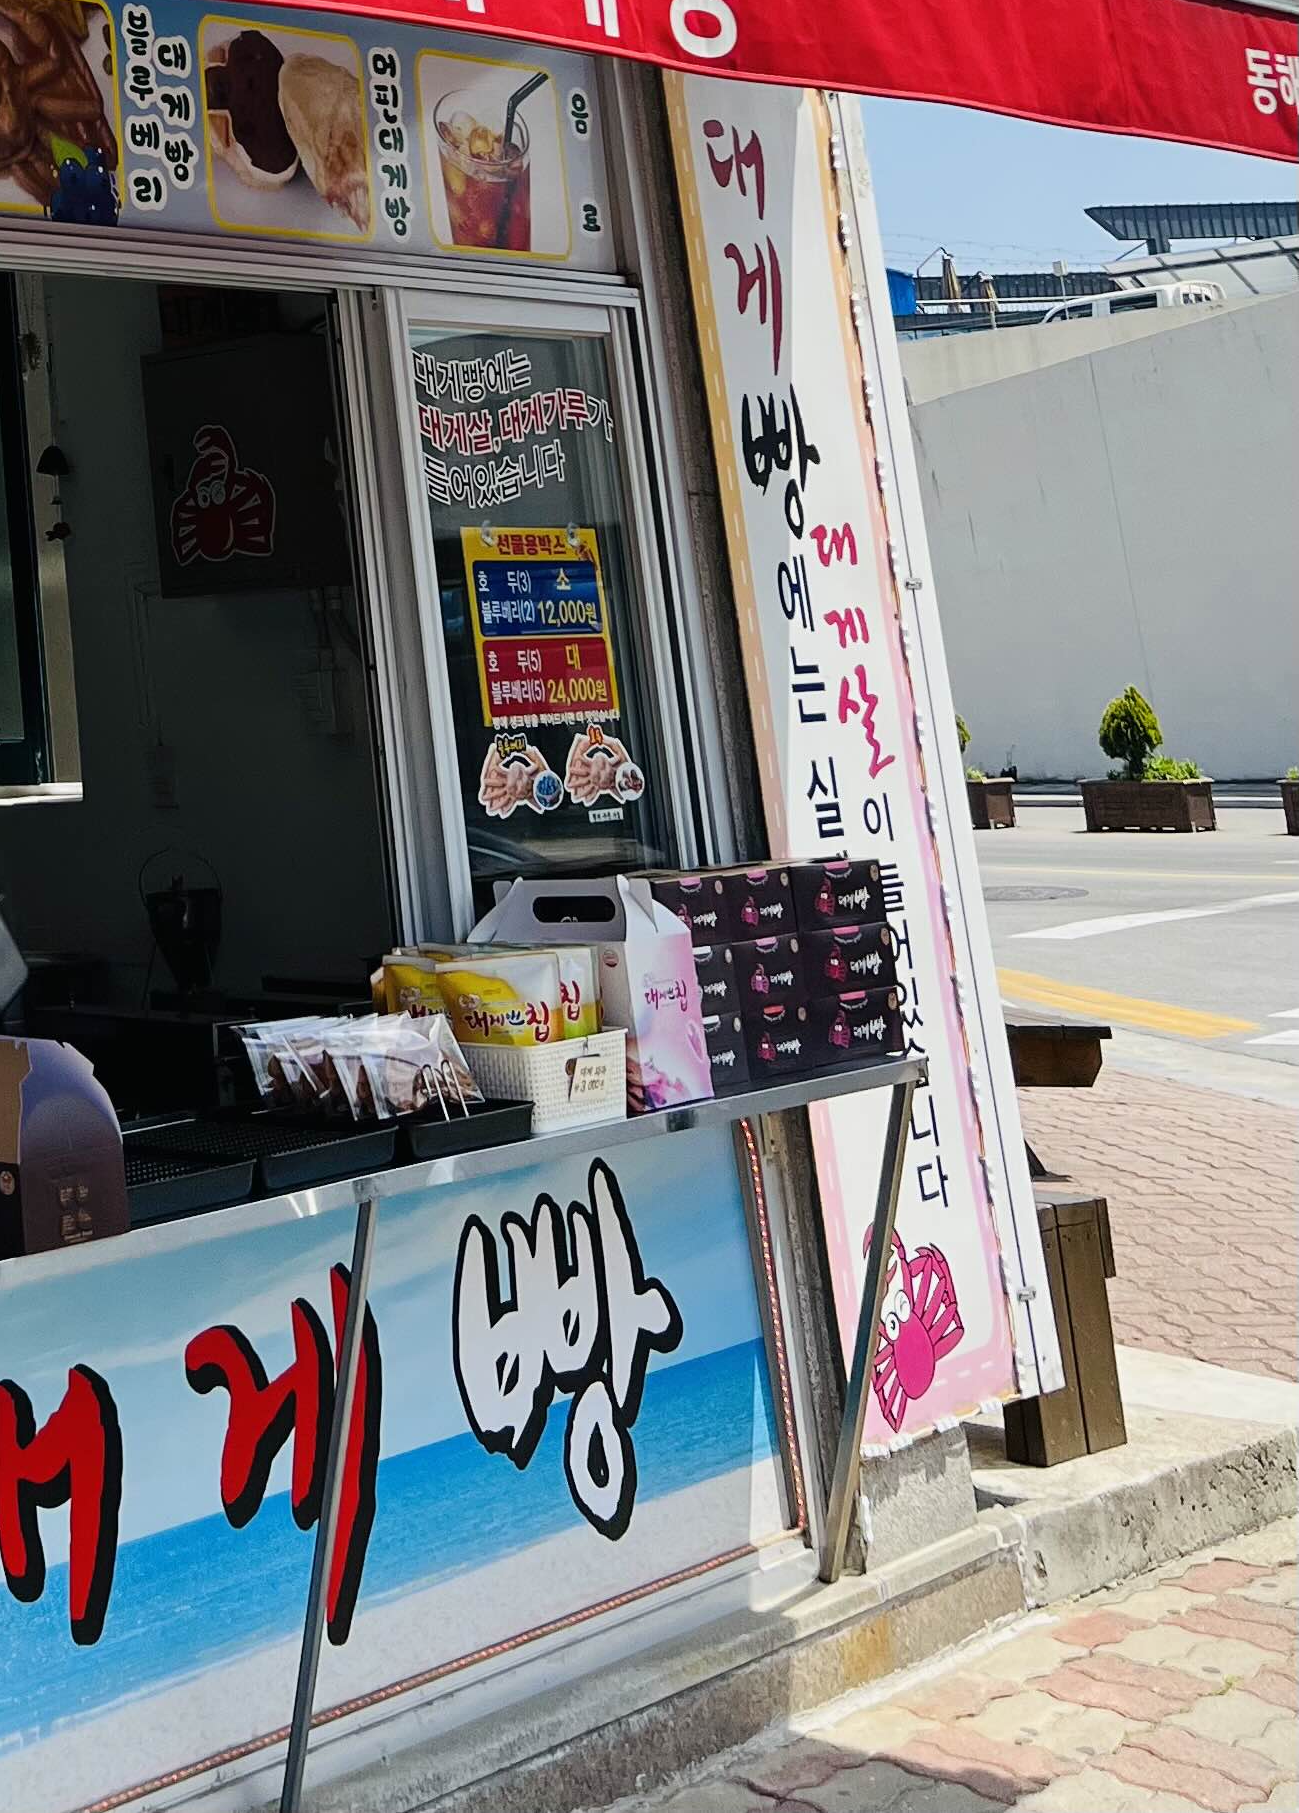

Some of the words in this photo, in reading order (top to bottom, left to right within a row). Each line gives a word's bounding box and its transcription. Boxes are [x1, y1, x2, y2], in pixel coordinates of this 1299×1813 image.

[412, 348, 532, 404] 대게빵에는
[423, 439, 565, 509] 들어있습니다
[497, 534, 567, 555] 선물용박스
[556, 567, 572, 590] 소
[537, 600, 598, 627] 12,000원
[565, 643, 582, 671] 대
[546, 677, 608, 706] 24,000원
